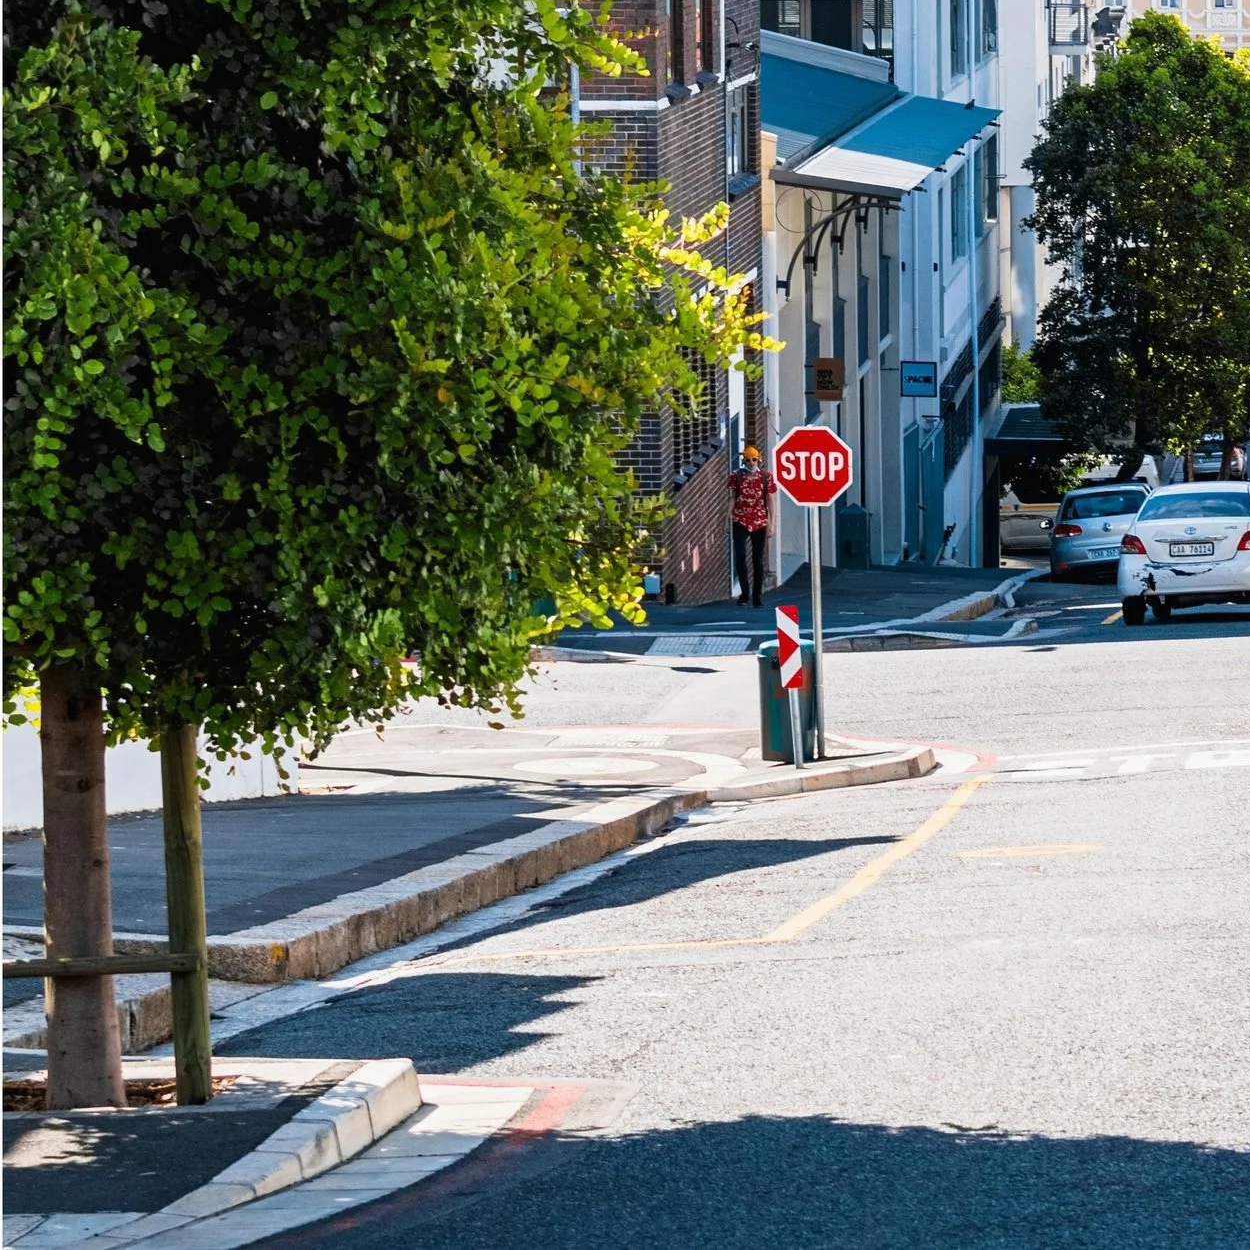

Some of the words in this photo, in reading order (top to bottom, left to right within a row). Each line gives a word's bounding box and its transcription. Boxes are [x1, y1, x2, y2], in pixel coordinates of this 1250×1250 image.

[781, 452, 844, 481] STOP
[1172, 545, 1185, 554] CAA
[1190, 544, 1212, 553] 76114
